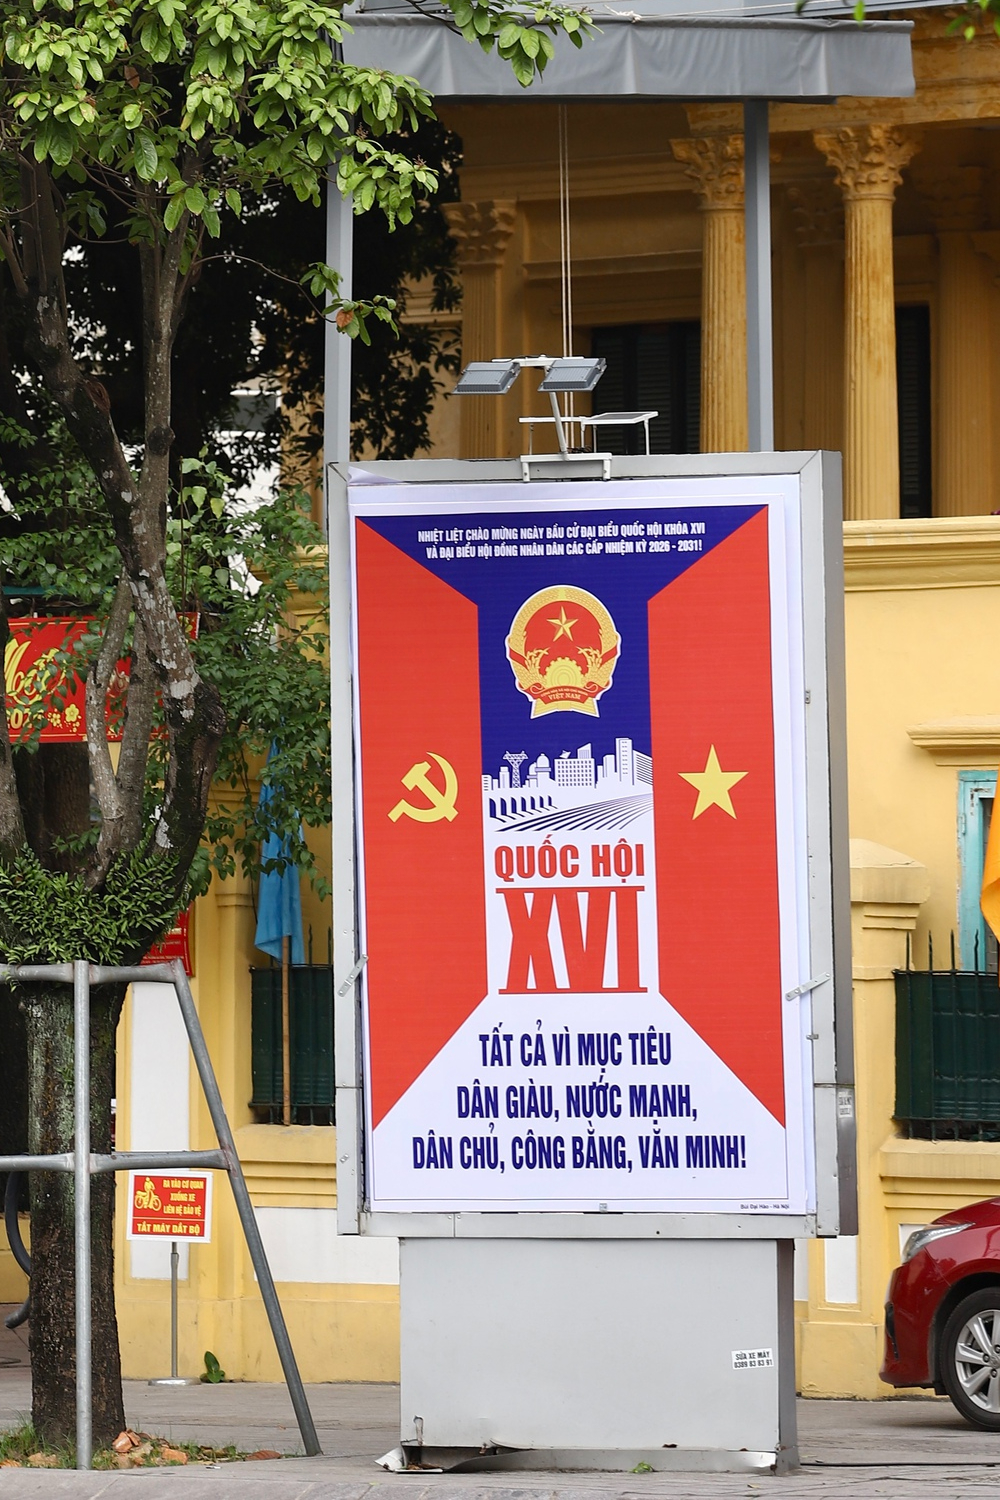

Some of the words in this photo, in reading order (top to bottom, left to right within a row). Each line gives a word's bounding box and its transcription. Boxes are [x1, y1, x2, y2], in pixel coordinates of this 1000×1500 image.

[418, 528, 444, 544] NHIỆT
[445, 527, 463, 544] LIỆT
[465, 526, 489, 541] CHÀO
[491, 525, 518, 541] MỪNG
[520, 525, 544, 540] NGÀY
[546, 523, 564, 539] BẦU
[566, 522, 580, 538] CỬ
[580, 526, 596, 540] ĐẠI
[598, 520, 619, 537] BIỂU
[620, 520, 645, 538] QUỐC
[646, 521, 662, 538] HỘI
[664, 520, 689, 535] KHÓA
[690, 522, 706, 535] XVI
[426, 544, 438, 559] VÀ
[439, 547, 454, 561] ĐẠI
[456, 541, 476, 558] BIỂU
[477, 543, 492, 560] HỘI
[494, 541, 518, 557] ĐỒNG
[520, 542, 545, 556] NHÂN
[546, 541, 564, 556] DÂN
[566, 541, 584, 555] CÁC
[585, 539, 604, 555] CẤP
[605, 539, 634, 556] NHIỆM
[635, 538, 647, 553] KỲ
[648, 540, 671, 553] 2026
[677, 539, 703, 552] 2031!
[565, 692, 581, 700] NAM
[494, 834, 580, 882] QUỐC
[591, 837, 645, 883] HỘI
[495, 885, 648, 995] XVI
[479, 1022, 513, 1067] TẤT
[520, 1019, 547, 1067] CẢ
[552, 1026, 571, 1066] VÌ
[577, 1033, 622, 1073] MỤC
[628, 1025, 672, 1066] TIÊU
[457, 1078, 499, 1118] DÂN
[506, 1078, 560, 1122] GIÀU,
[566, 1075, 622, 1118] NƯỚC
[629, 1084, 697, 1125] MẠNH,
[412, 1129, 453, 1169] DÂN
[460, 1122, 505, 1173] CHỦ,
[511, 1129, 565, 1170] CÔNG
[571, 1120, 632, 1173] BẰNG,
[638, 1128, 679, 1168] VĂN
[685, 1135, 746, 1169] MINH!
[153, 1223, 170, 1233] MÁY
